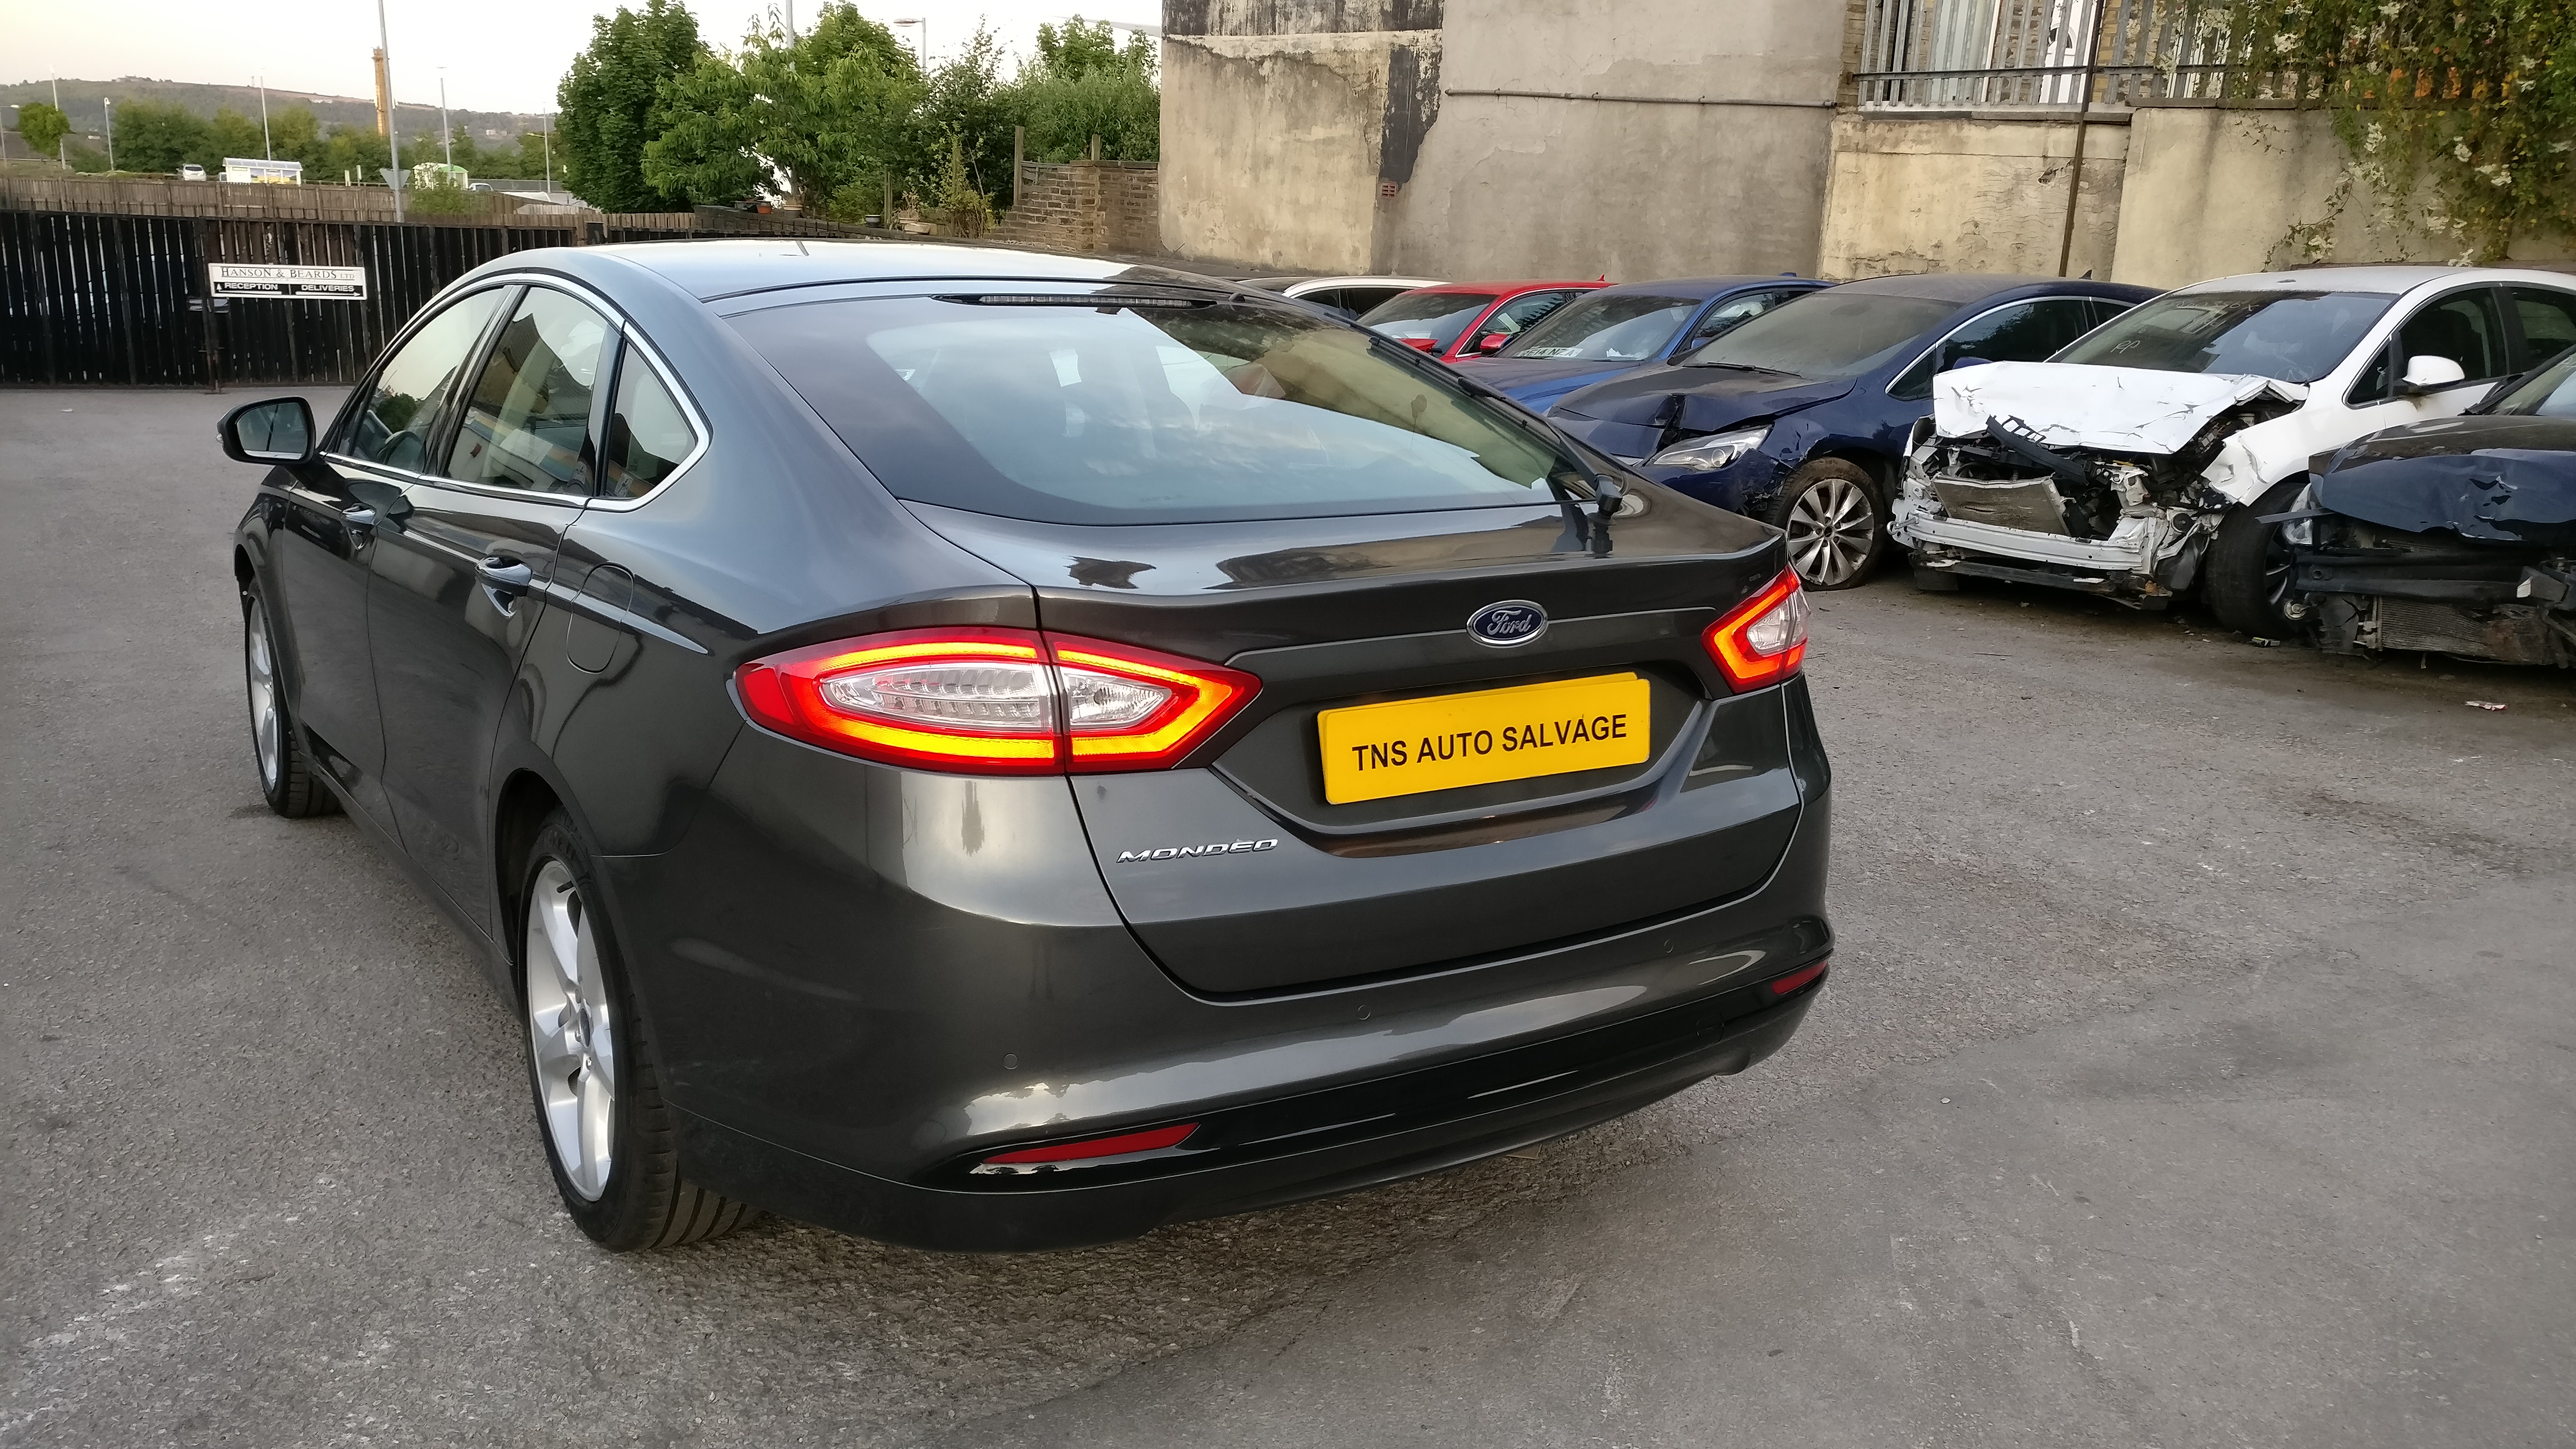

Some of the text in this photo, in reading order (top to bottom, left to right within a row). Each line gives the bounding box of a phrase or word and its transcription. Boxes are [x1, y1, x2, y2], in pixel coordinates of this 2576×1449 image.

[222, 267, 271, 277] HANSON
[276, 269, 285, 278] &
[290, 269, 336, 279] BEARDS
[1487, 610, 1532, 635] Ford
[1352, 714, 1627, 771] TNS AUTO SALVAGE
[1115, 839, 1278, 863] MONDEO
